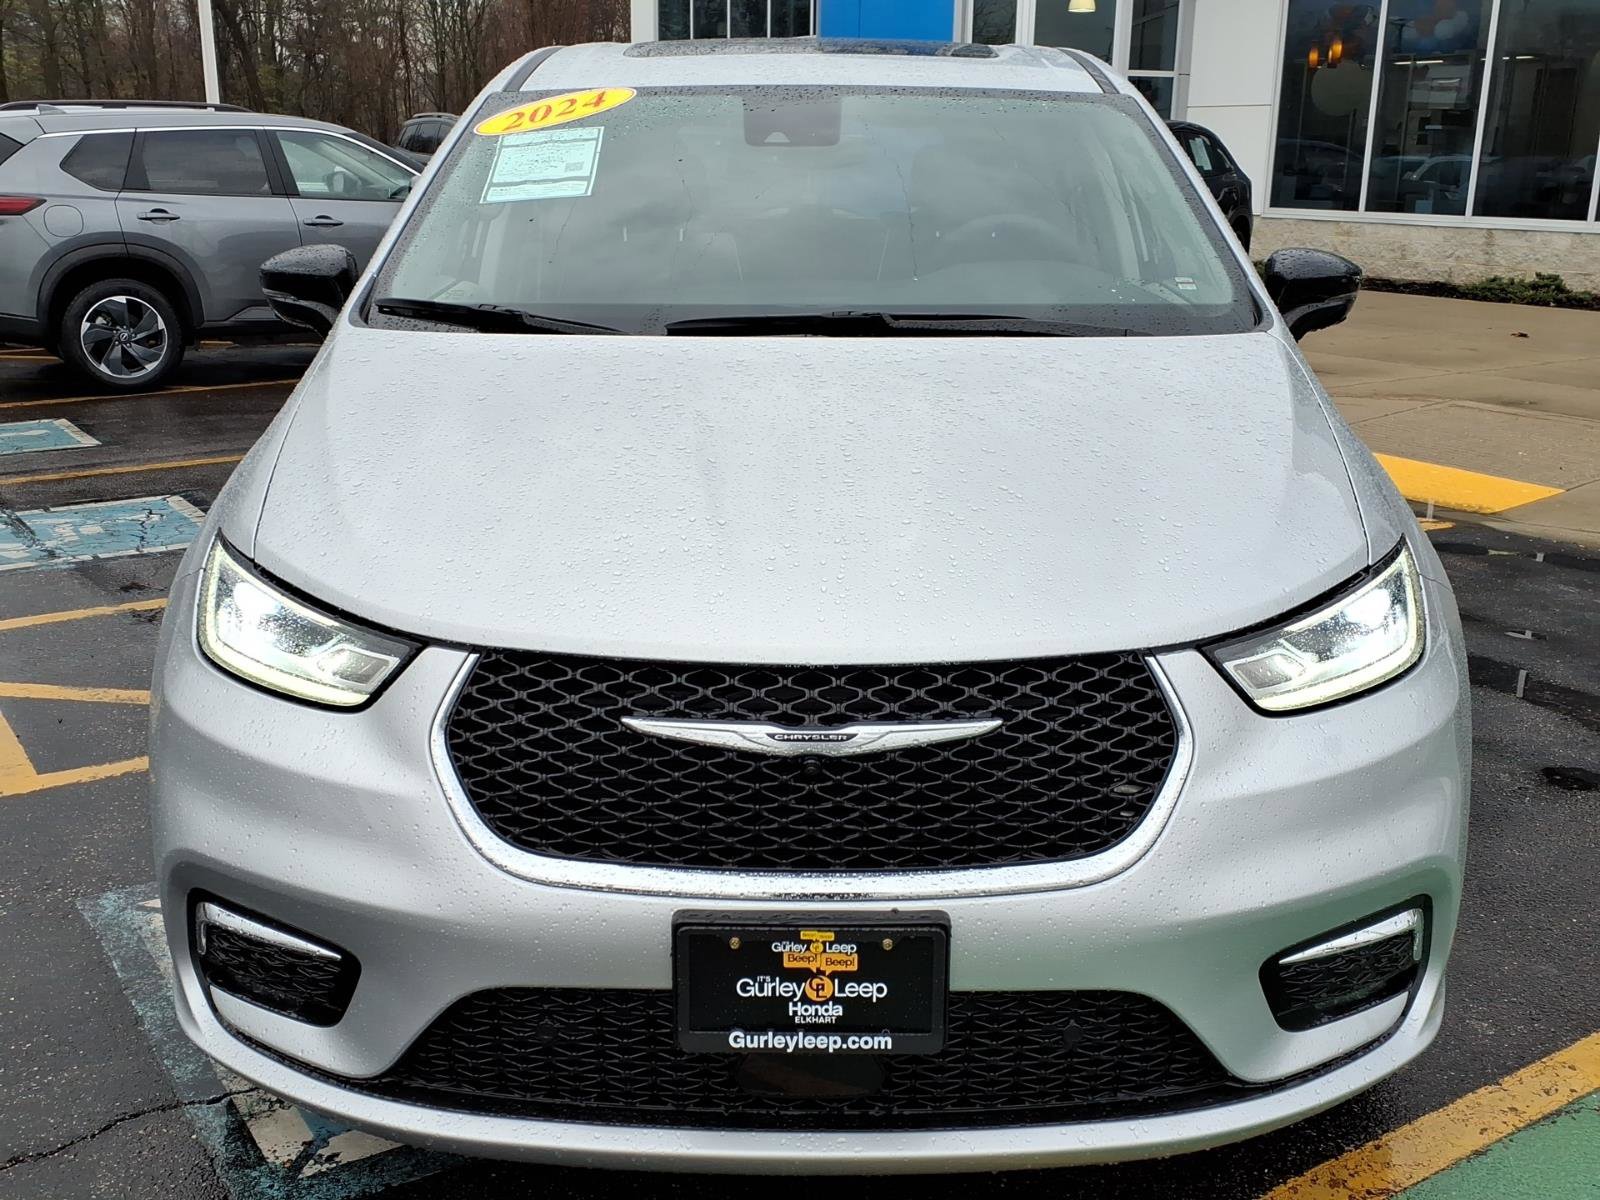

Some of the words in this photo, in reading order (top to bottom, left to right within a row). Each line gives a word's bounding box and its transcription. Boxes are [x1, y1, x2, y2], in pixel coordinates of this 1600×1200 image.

[502, 91, 606, 131] 2024
[826, 941, 857, 955] Leep
[787, 953, 817, 965] Beep!
[825, 957, 855, 968] Beep!
[736, 977, 805, 1001] Gurley
[834, 978, 888, 1003] Leep
[788, 1001, 843, 1016] Honda
[795, 1016, 837, 1024] ELKHART
[728, 1031, 892, 1052] Gurleyleep.com
